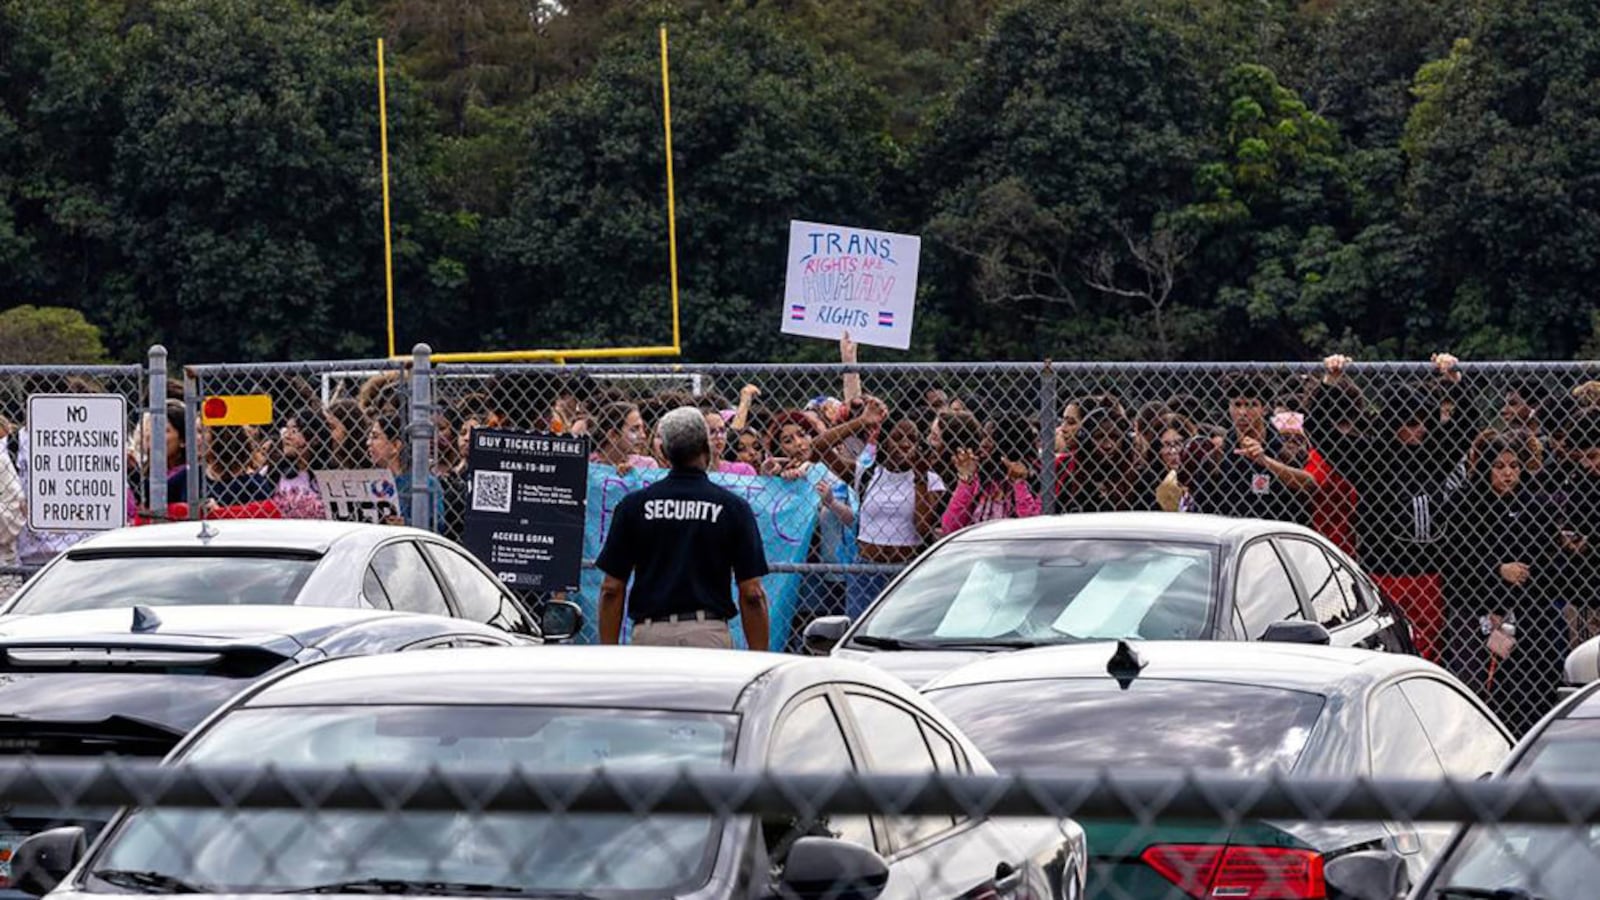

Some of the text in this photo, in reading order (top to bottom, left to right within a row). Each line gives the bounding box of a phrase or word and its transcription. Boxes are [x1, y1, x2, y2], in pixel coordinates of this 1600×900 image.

[808, 232, 891, 259] TRANS
[804, 256, 858, 275] RIGHTS
[802, 272, 896, 306] HUMAN
[815, 305, 870, 328] RIGHTS
[66, 405, 88, 423] NO
[36, 429, 119, 448] TRESPASSING
[478, 435, 501, 448] BUY
[504, 438, 550, 451] TICKETS
[552, 441, 581, 454] HERE
[34, 454, 121, 472] OR LOITERING
[500, 460, 557, 473] SCAN-TO-BUY
[39, 479, 116, 497] ON SCHOOL
[43, 503, 112, 521] PROPERTY
[643, 499, 723, 523] SECURITY
[491, 531, 524, 542] ACCESS
